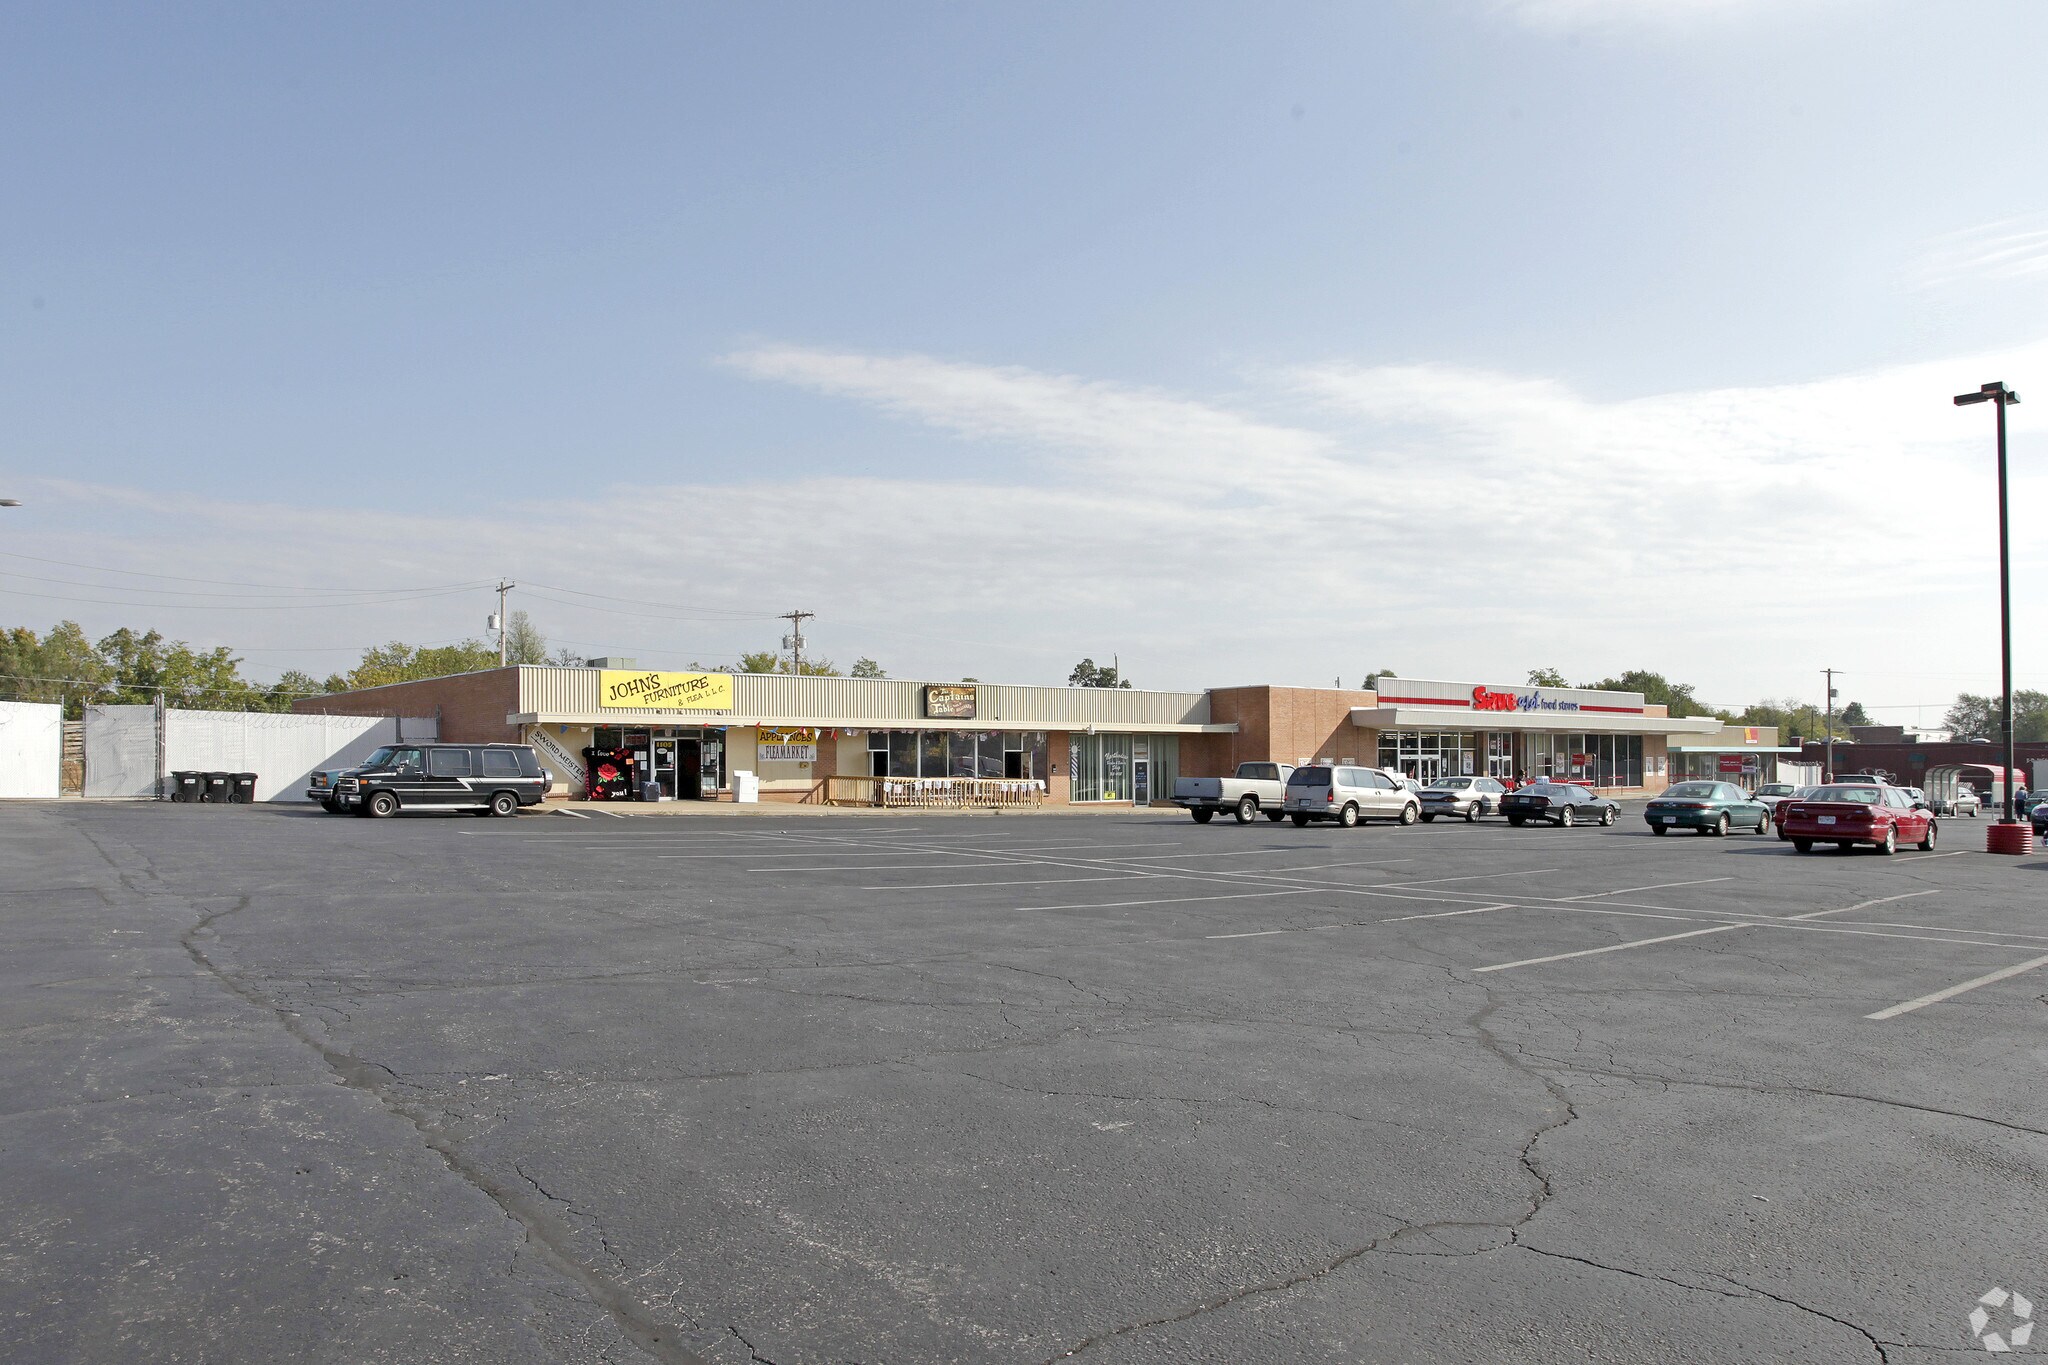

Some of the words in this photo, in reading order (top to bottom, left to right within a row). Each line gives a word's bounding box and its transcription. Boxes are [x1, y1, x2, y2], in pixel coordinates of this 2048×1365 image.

[610, 673, 661, 701] JOHN'S
[643, 676, 709, 705] FURNITURE
[677, 699, 684, 707] &
[686, 692, 703, 704] FLEA
[929, 690, 975, 704] Captains
[1472, 685, 1518, 711] Save
[1541, 698, 1557, 710] food
[1558, 700, 1579, 711] stores
[930, 703, 954, 714] Table
[534, 730, 560, 754] SWORD
[559, 752, 585, 778] MEISTER
